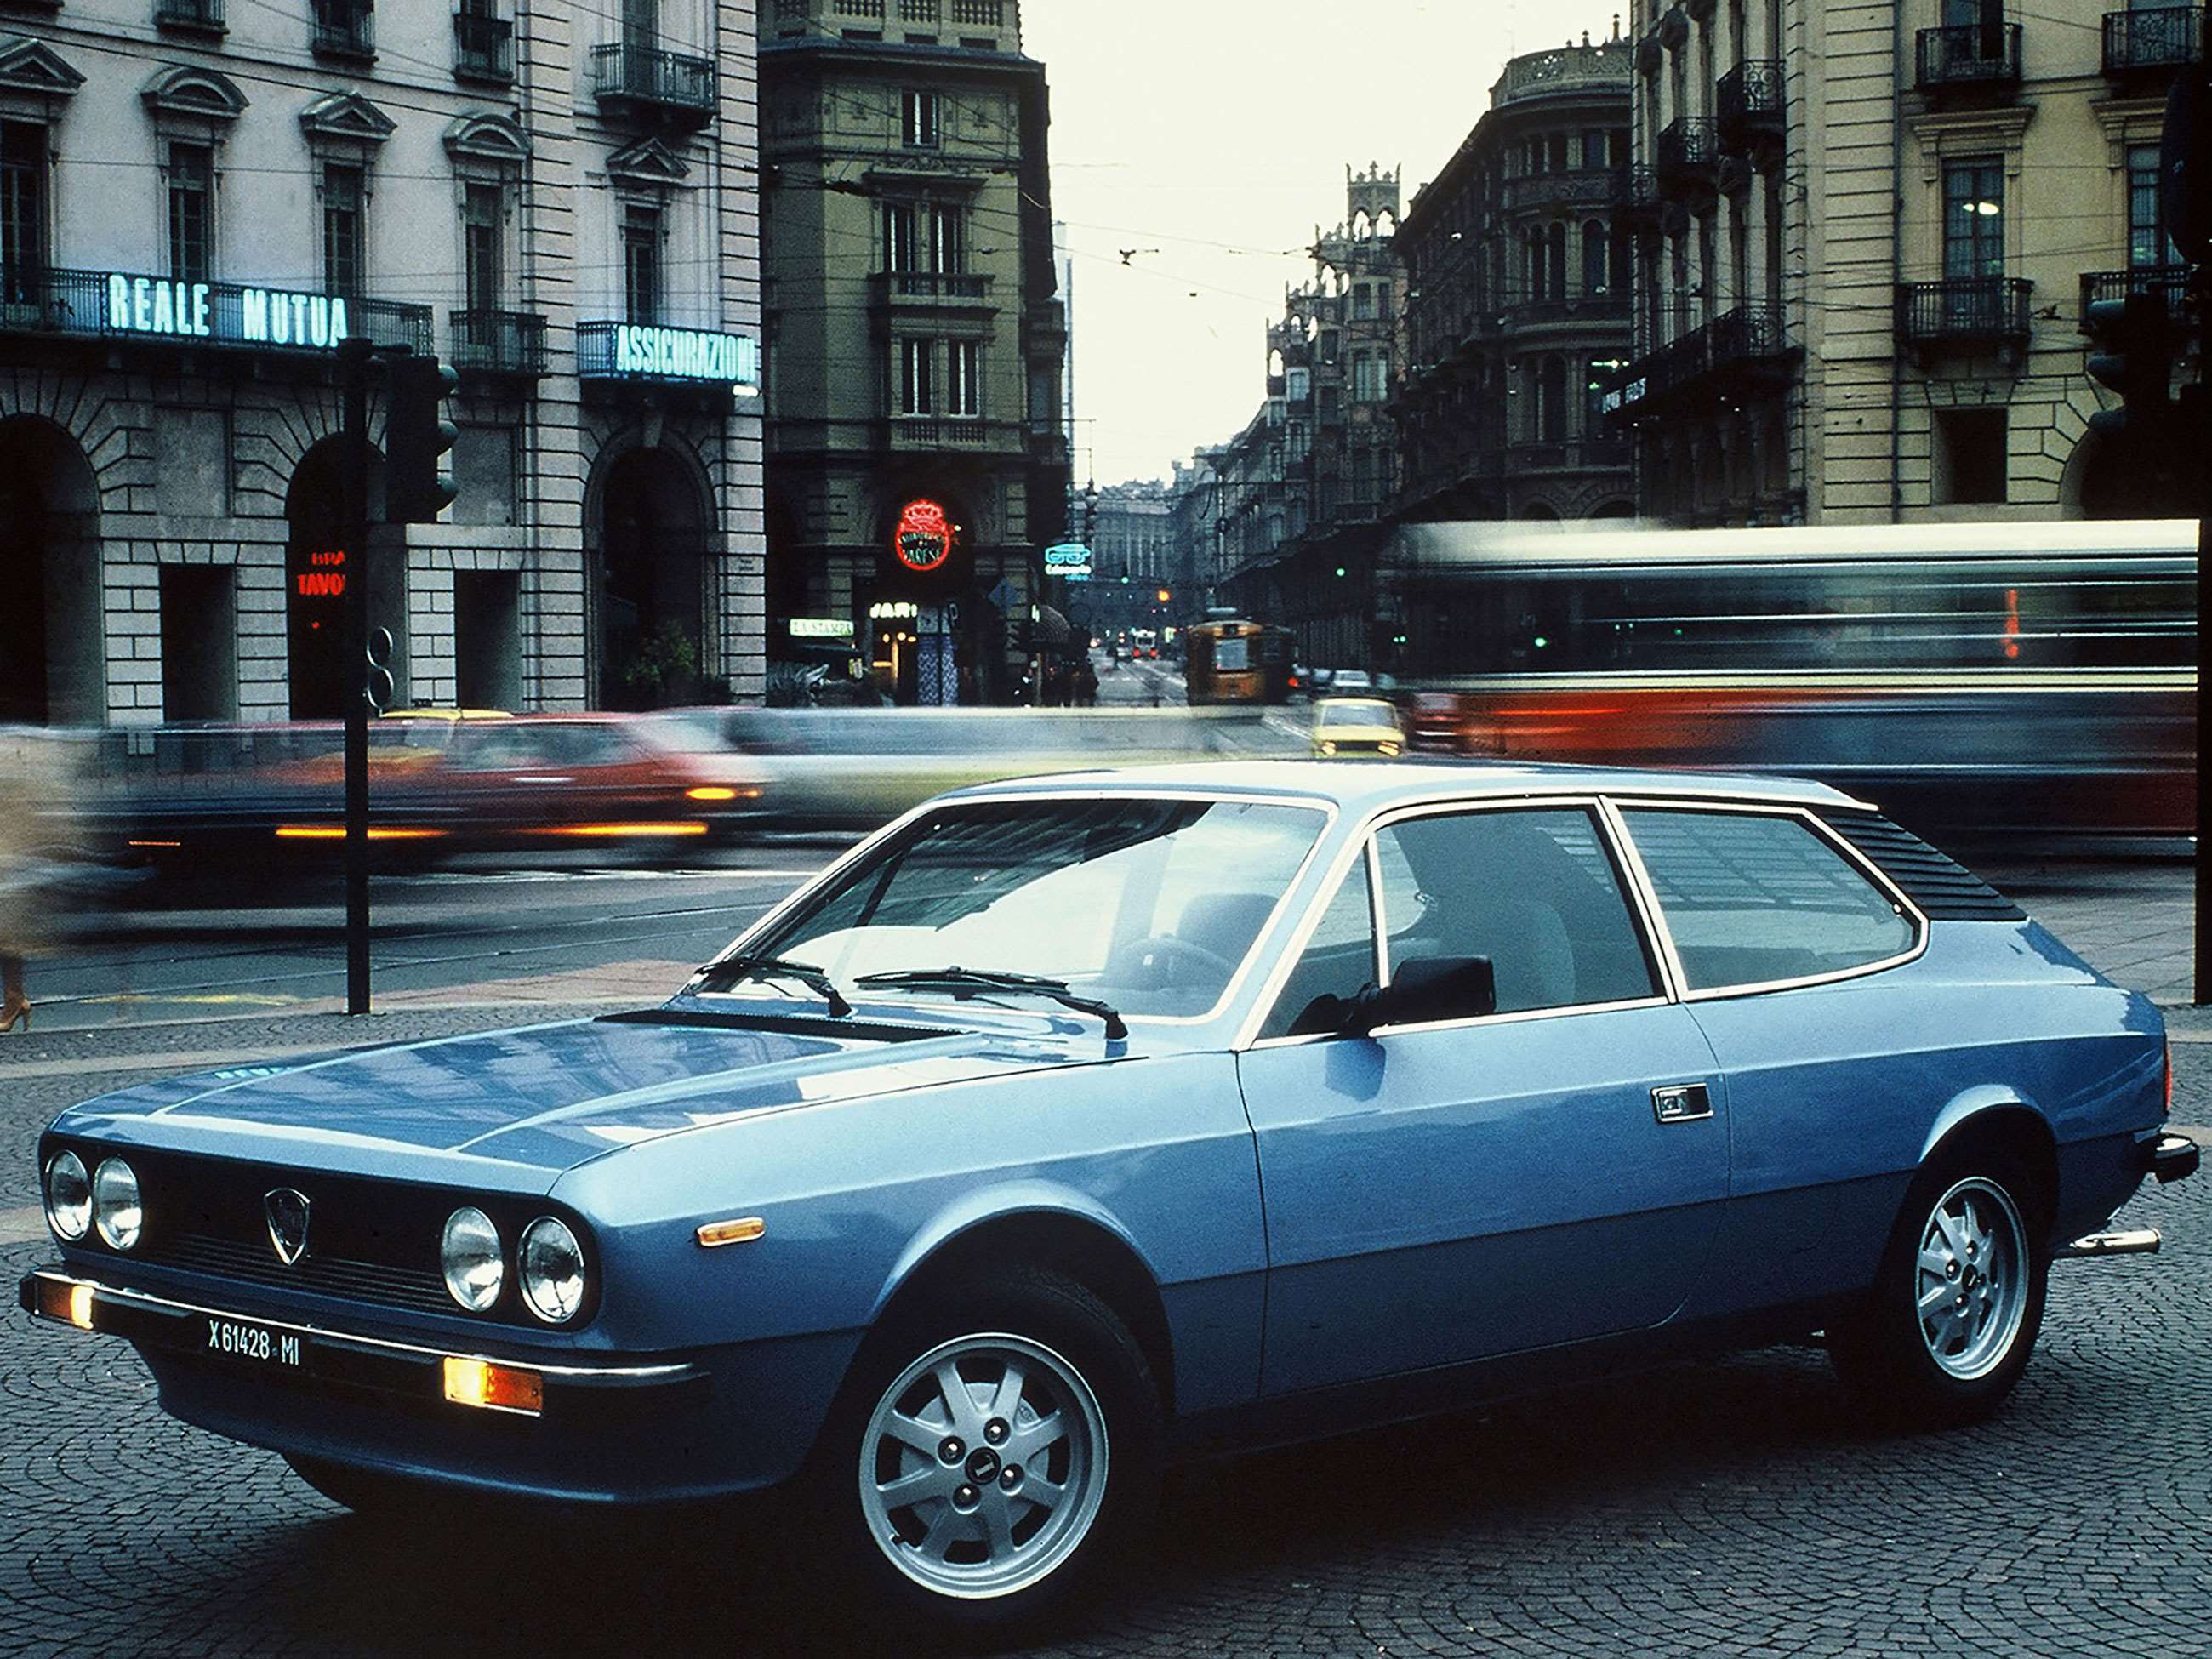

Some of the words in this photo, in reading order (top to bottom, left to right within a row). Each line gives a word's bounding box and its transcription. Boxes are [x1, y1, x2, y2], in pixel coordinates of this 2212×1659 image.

[109, 274, 210, 336] REALE
[242, 288, 347, 347] MUTUA
[616, 325, 755, 382] ASSICURAZIONI
[282, 1335, 299, 1365] MI
